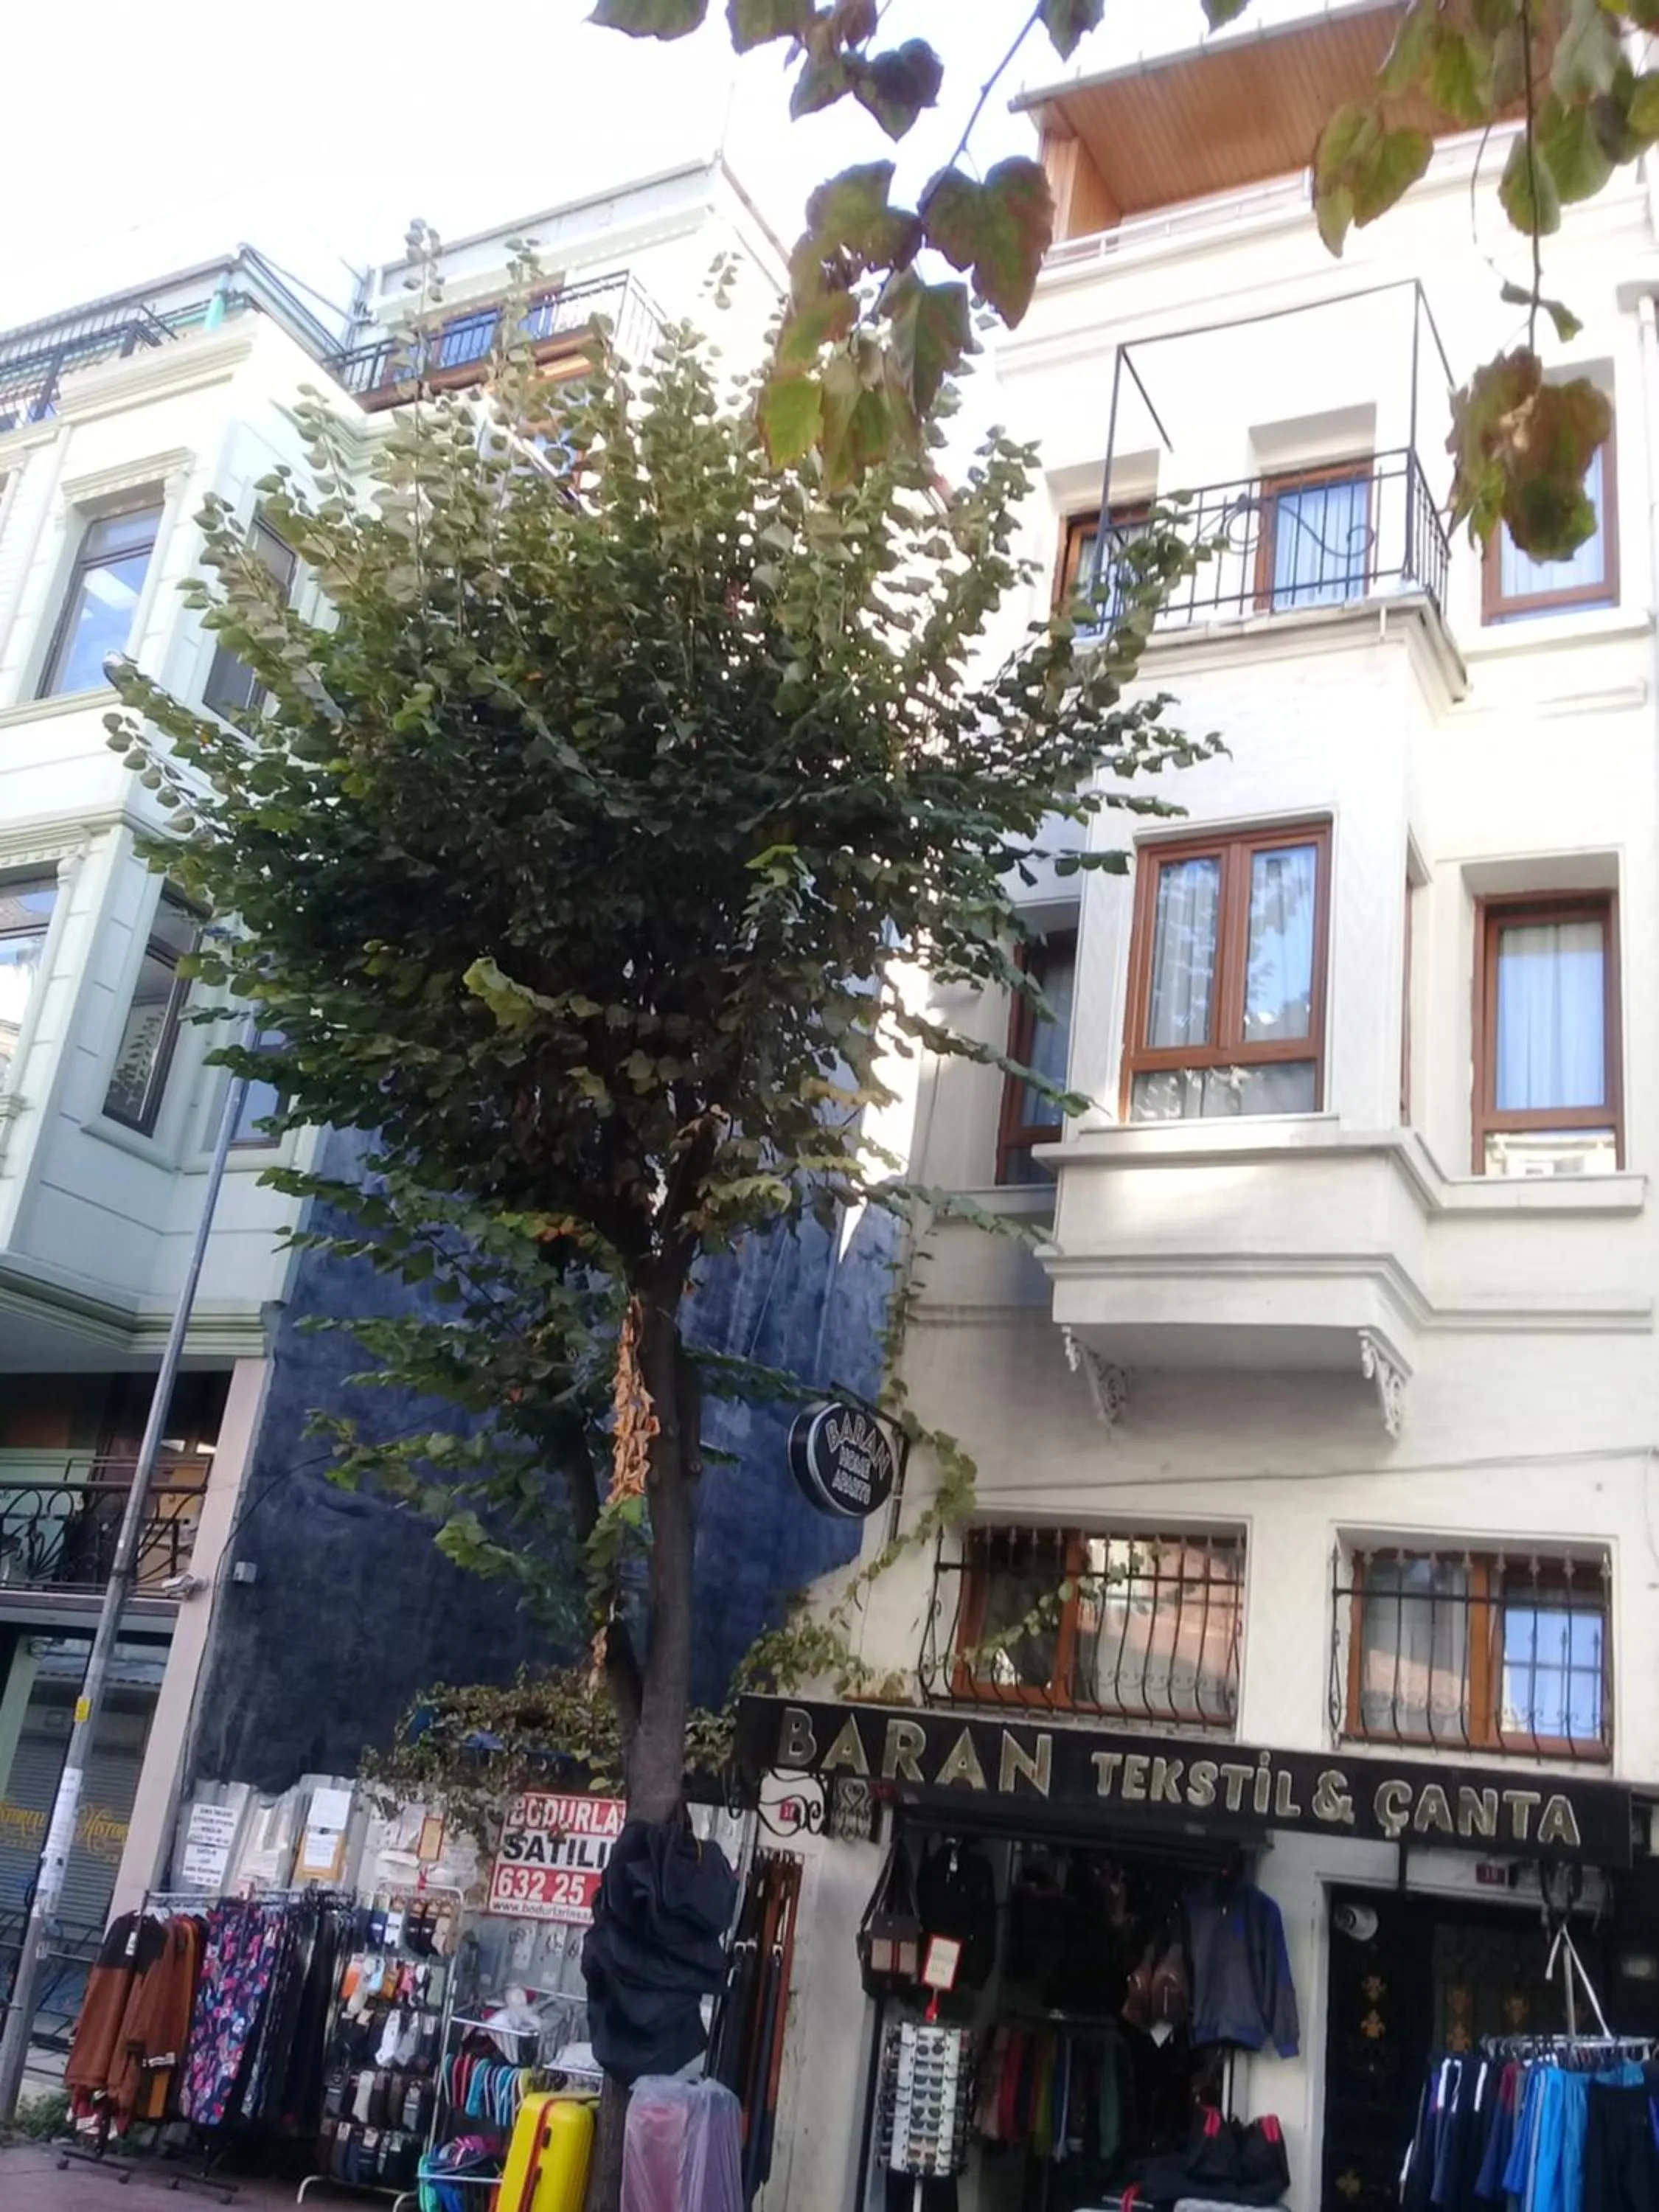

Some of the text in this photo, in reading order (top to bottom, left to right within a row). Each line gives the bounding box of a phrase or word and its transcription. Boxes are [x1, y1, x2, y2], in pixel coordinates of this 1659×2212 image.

[825, 1411, 891, 1481] BARAN
[776, 1705, 1581, 1848] BARAN TEKSTİL & ÇANTA
[504, 1832, 609, 1869] SATILI
[498, 1867, 585, 1905] 632 25
